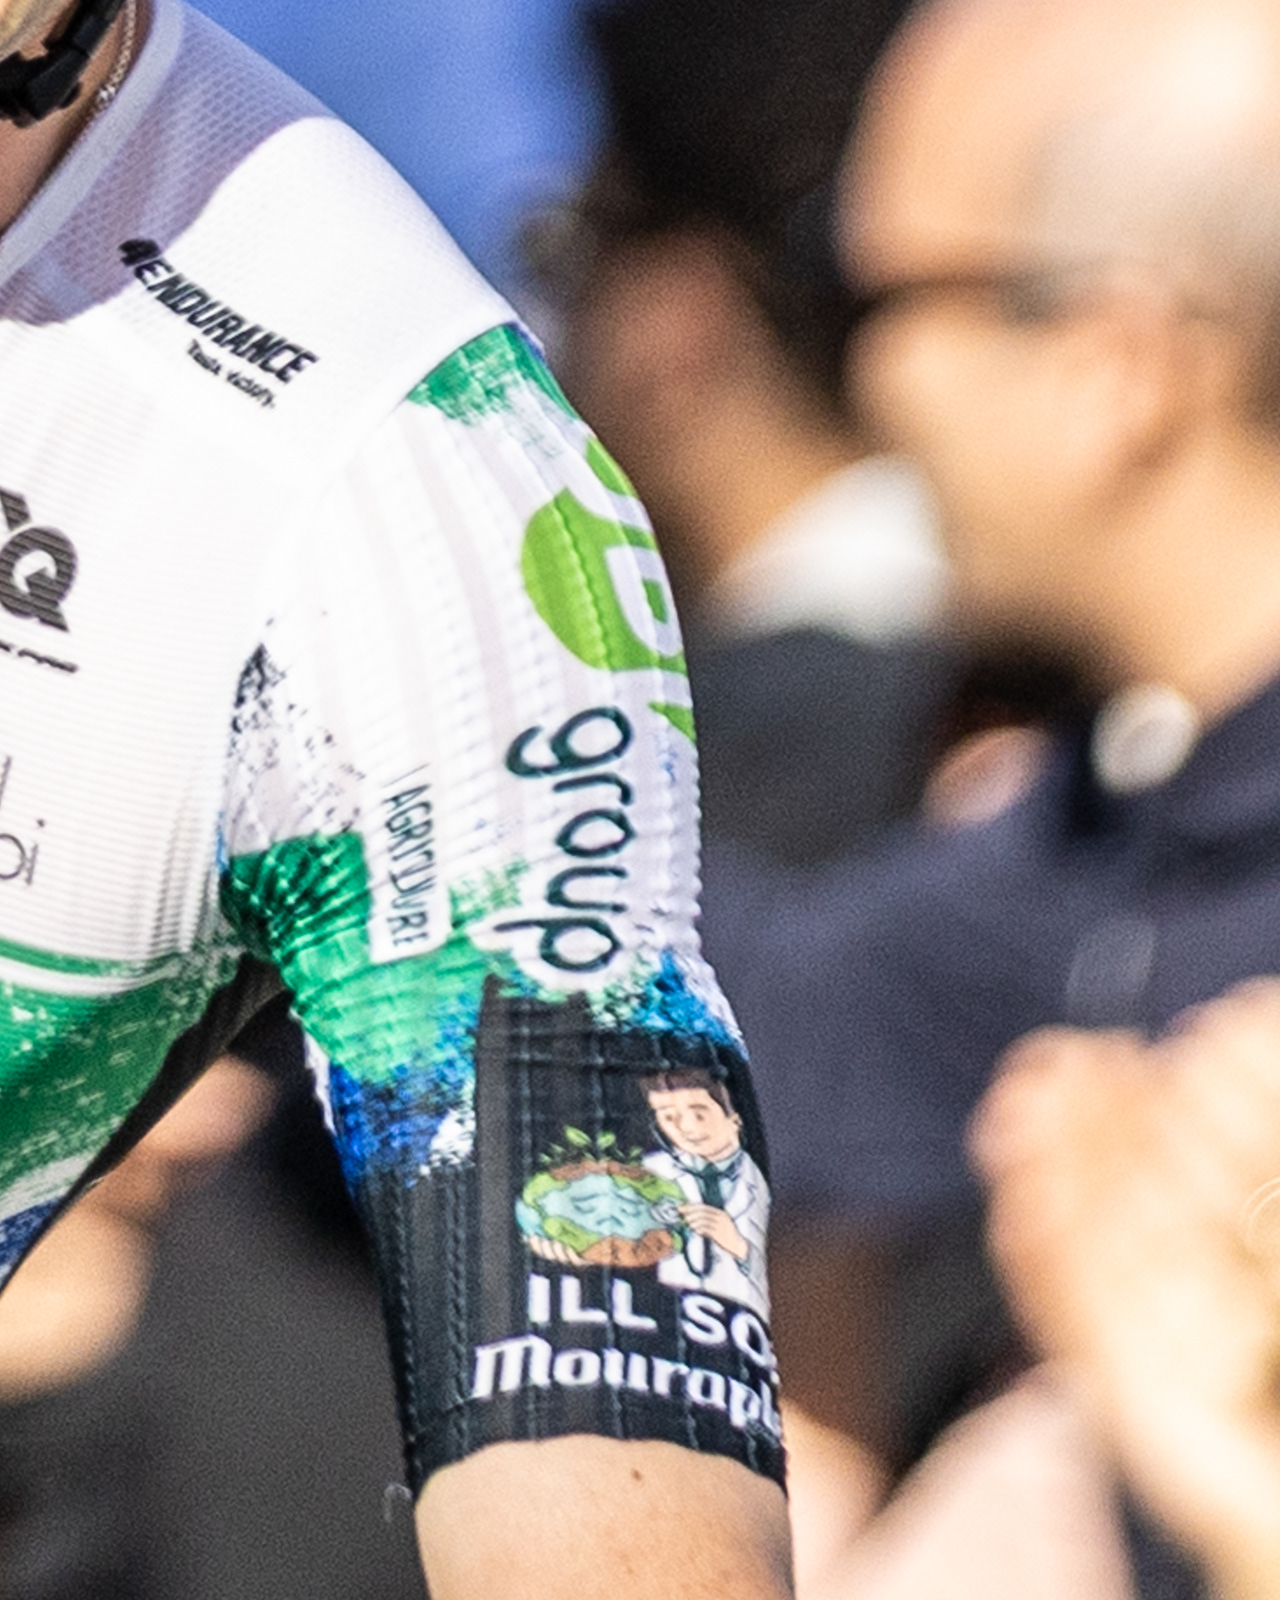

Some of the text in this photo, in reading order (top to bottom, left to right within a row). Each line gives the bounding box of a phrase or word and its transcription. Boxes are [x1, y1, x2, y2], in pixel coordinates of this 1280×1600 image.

[133, 257, 320, 384] ENDURANCE
[505, 704, 639, 974] group
[471, 1333, 783, 1440] Mourapl
[680, 1292, 781, 1386] SO
